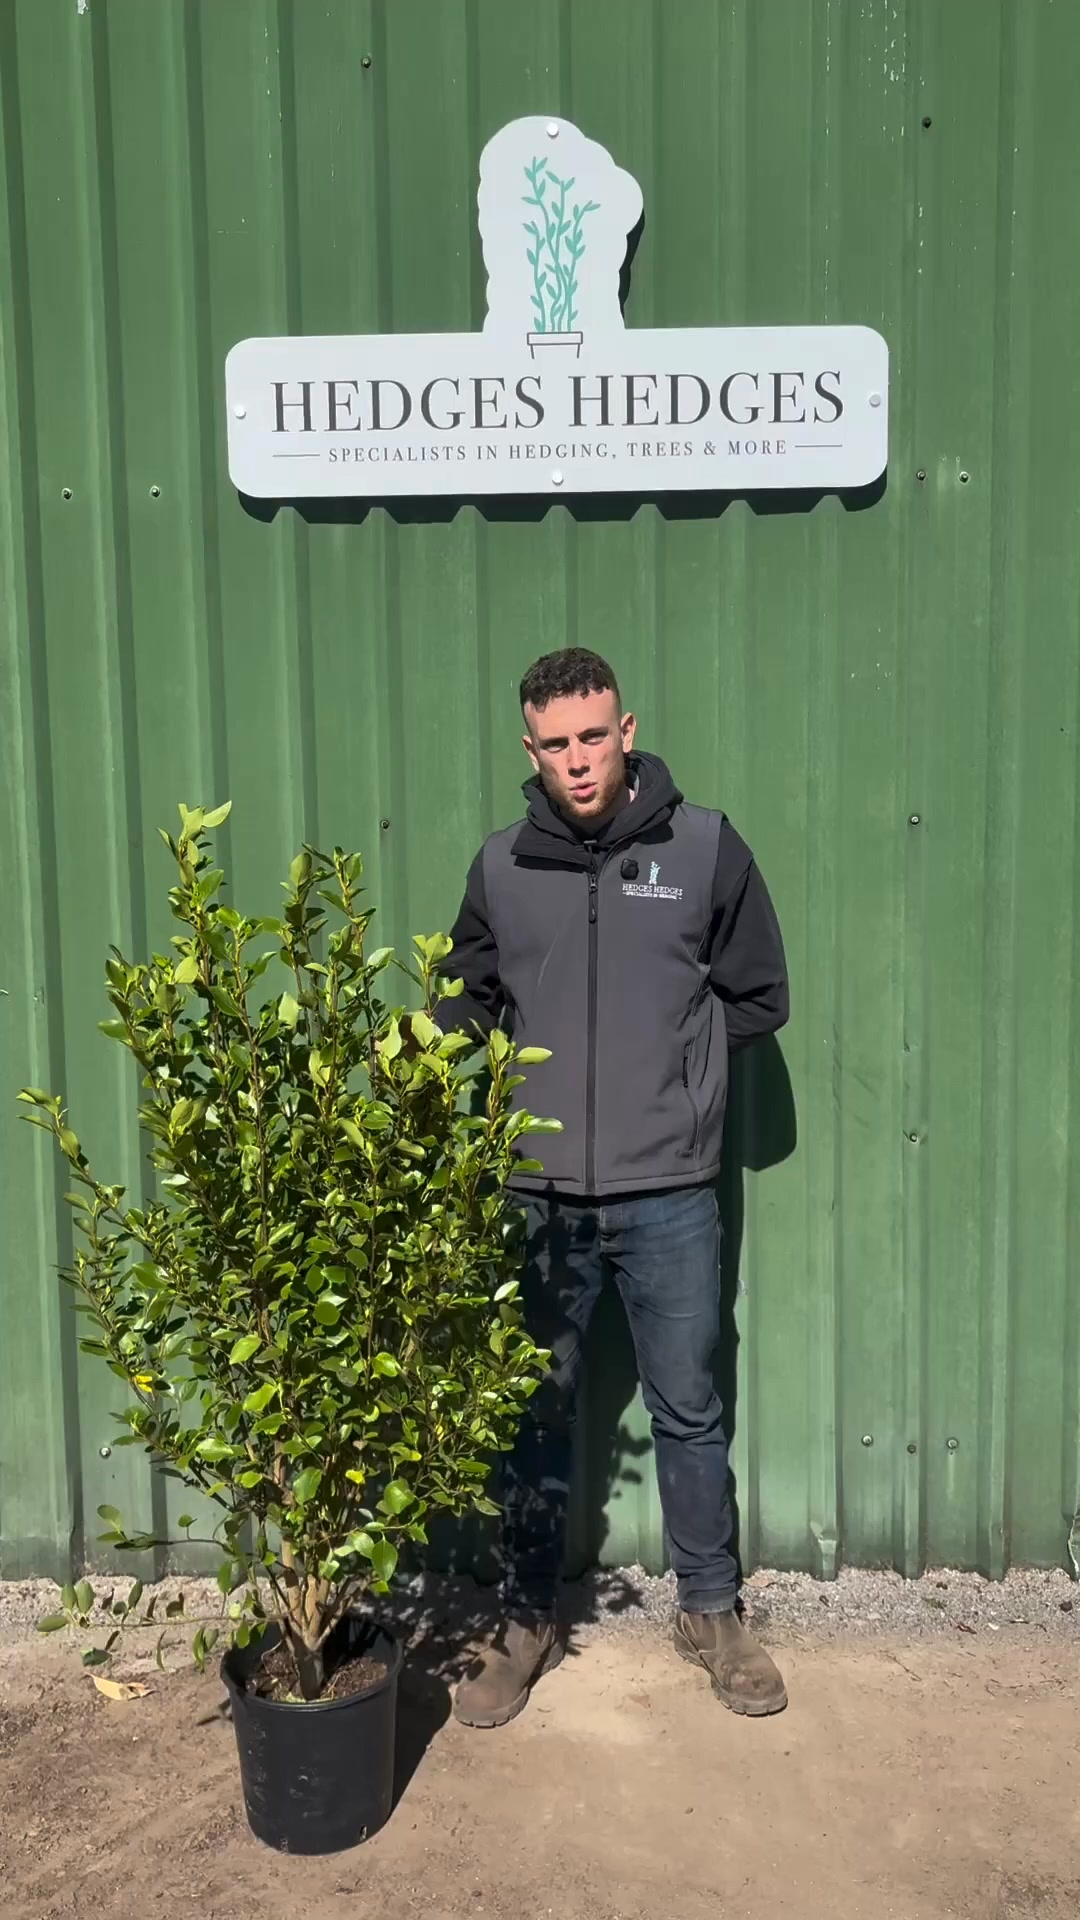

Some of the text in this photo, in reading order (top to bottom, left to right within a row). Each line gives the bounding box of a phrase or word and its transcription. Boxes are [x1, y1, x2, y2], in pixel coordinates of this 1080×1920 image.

[272, 371, 844, 432] HEDGES HEDGES
[329, 440, 786, 462] SPECIALISTS IN HEDGING, TREES & MORE
[622, 883, 683, 896] HEDGES HEDGES
